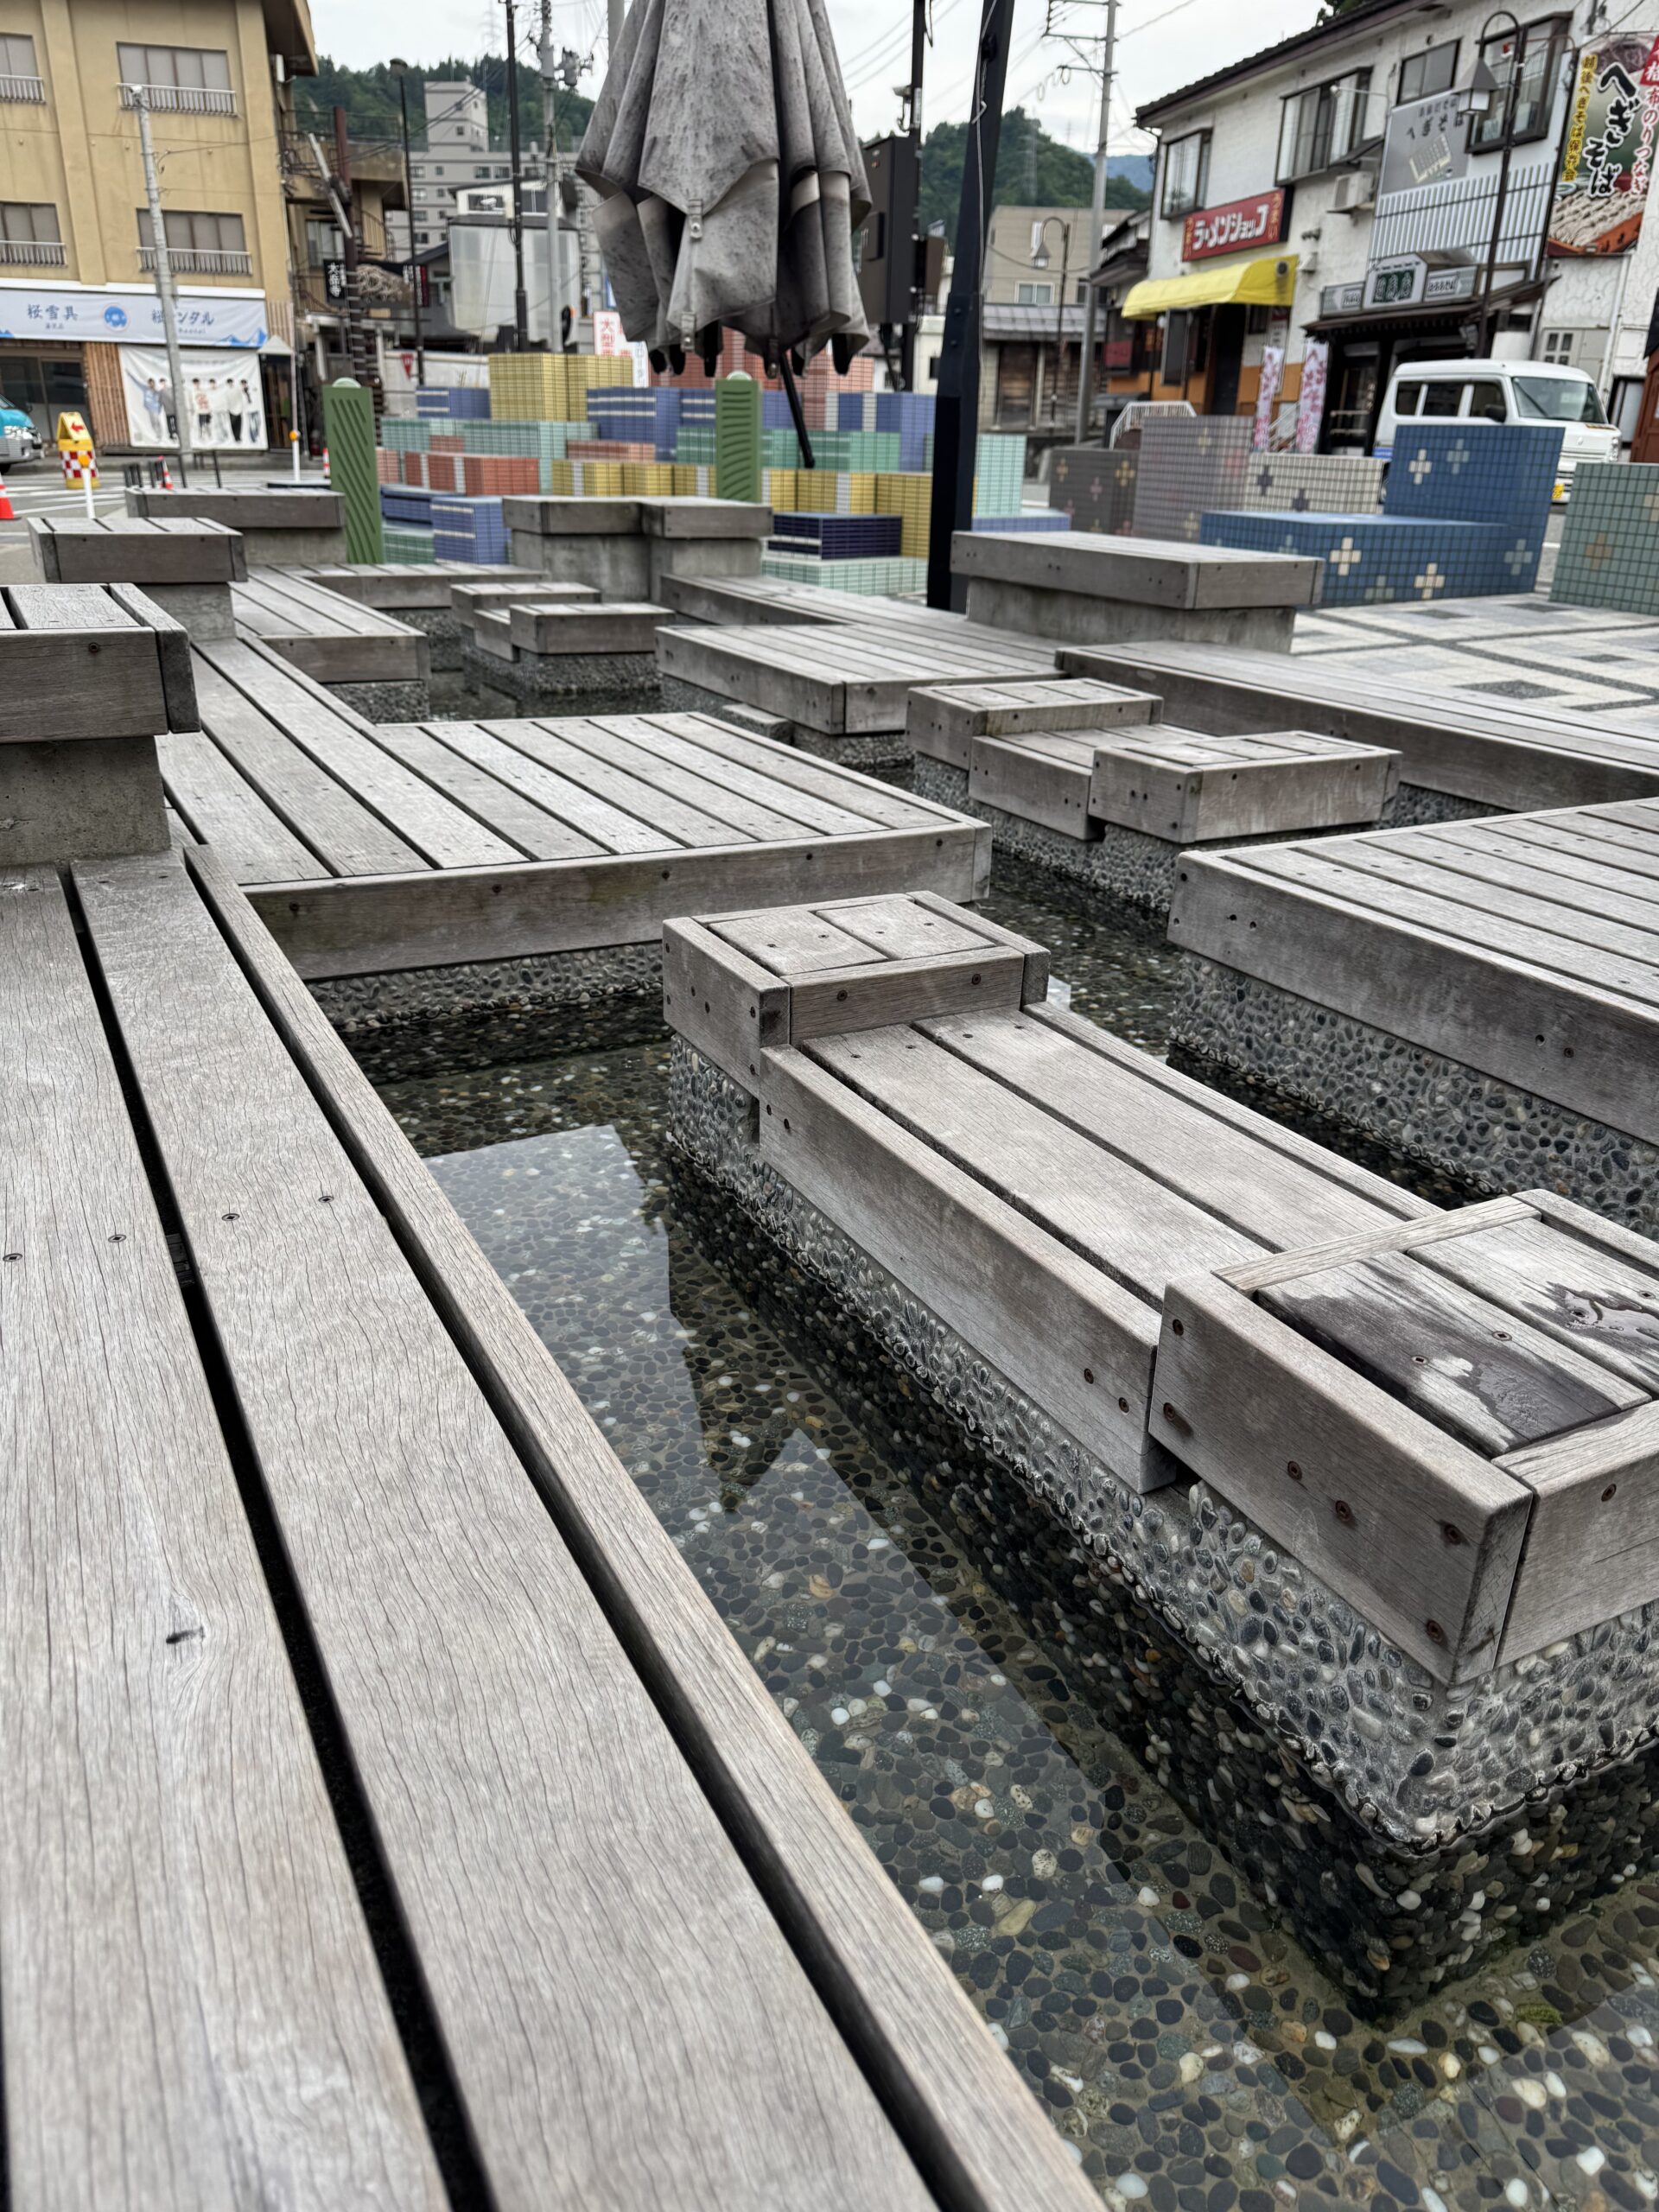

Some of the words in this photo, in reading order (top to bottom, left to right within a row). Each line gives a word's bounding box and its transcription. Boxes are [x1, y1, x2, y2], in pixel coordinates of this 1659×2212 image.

[1583, 63, 1640, 197] へぎそば
[1192, 204, 1269, 251] ラーメンショップ
[151, 308, 214, 326] 桜ンタル
